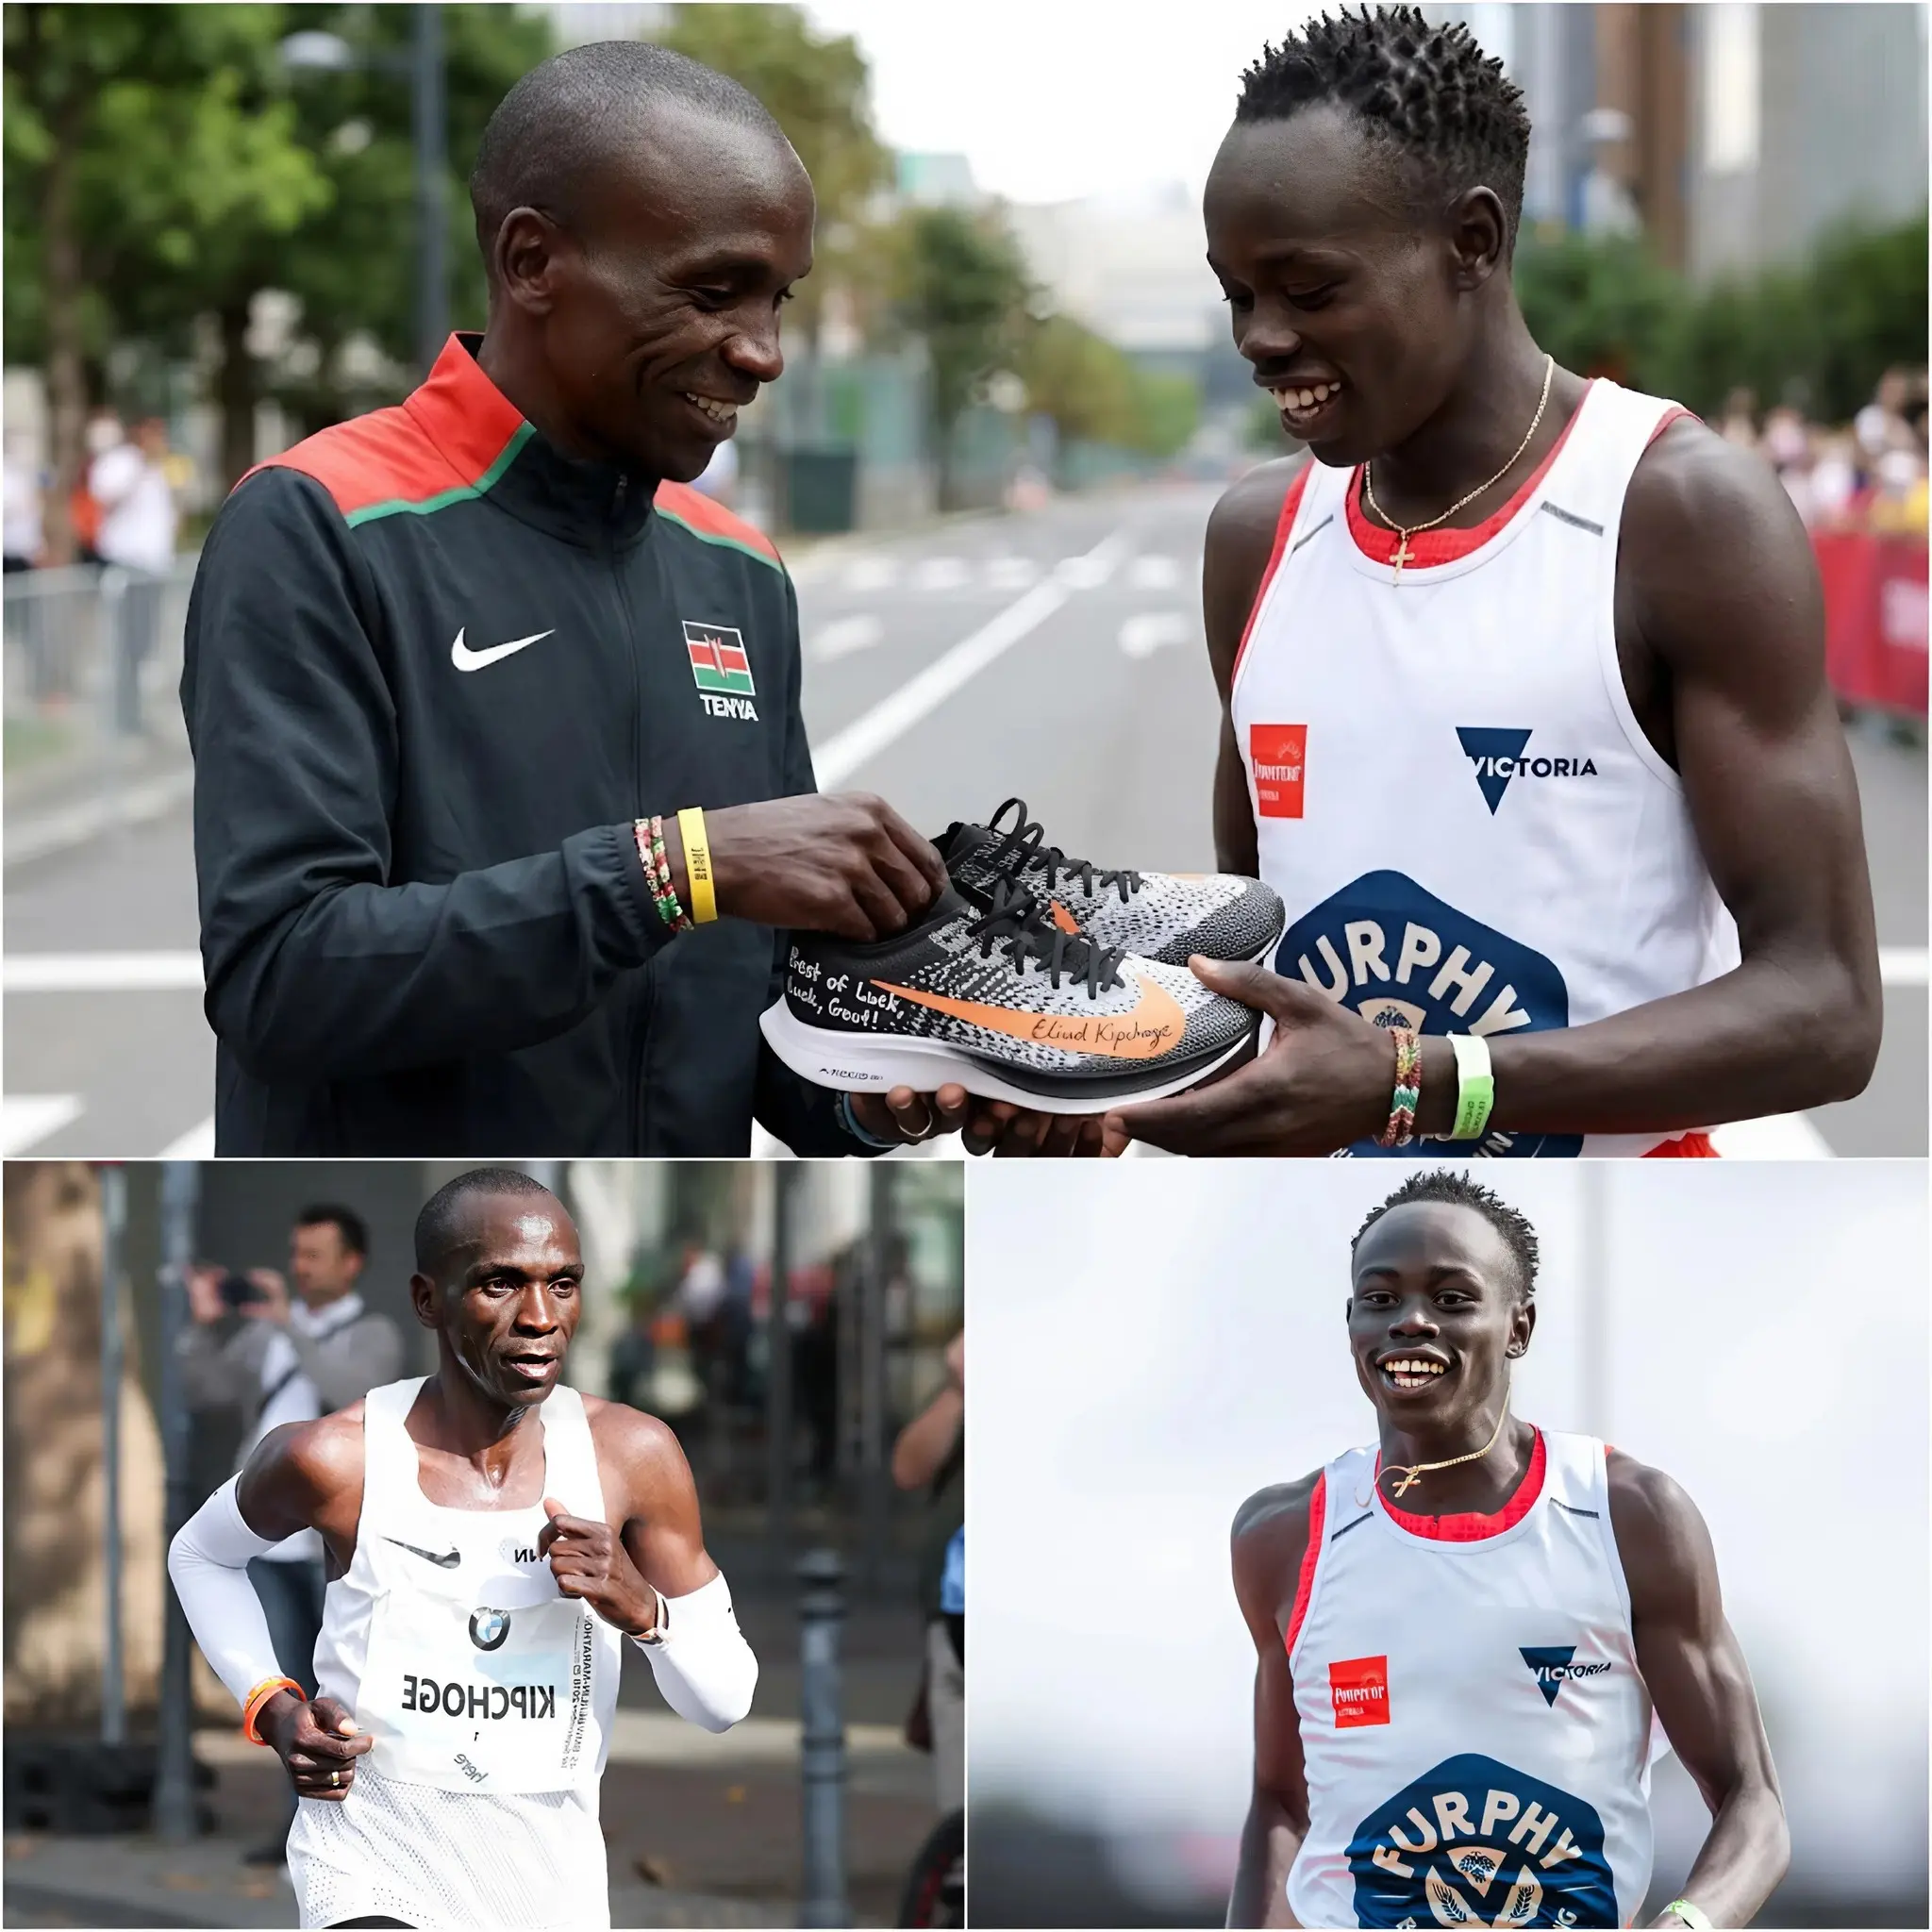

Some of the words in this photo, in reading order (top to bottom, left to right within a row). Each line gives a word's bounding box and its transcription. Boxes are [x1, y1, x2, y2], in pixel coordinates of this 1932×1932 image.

[1469, 756, 1598, 778] VICTORIA
[1298, 920, 1532, 1037] URPHY
[1531, 1661, 1611, 1682] VICTORIA
[1372, 1789, 1583, 1879] FURPHY
